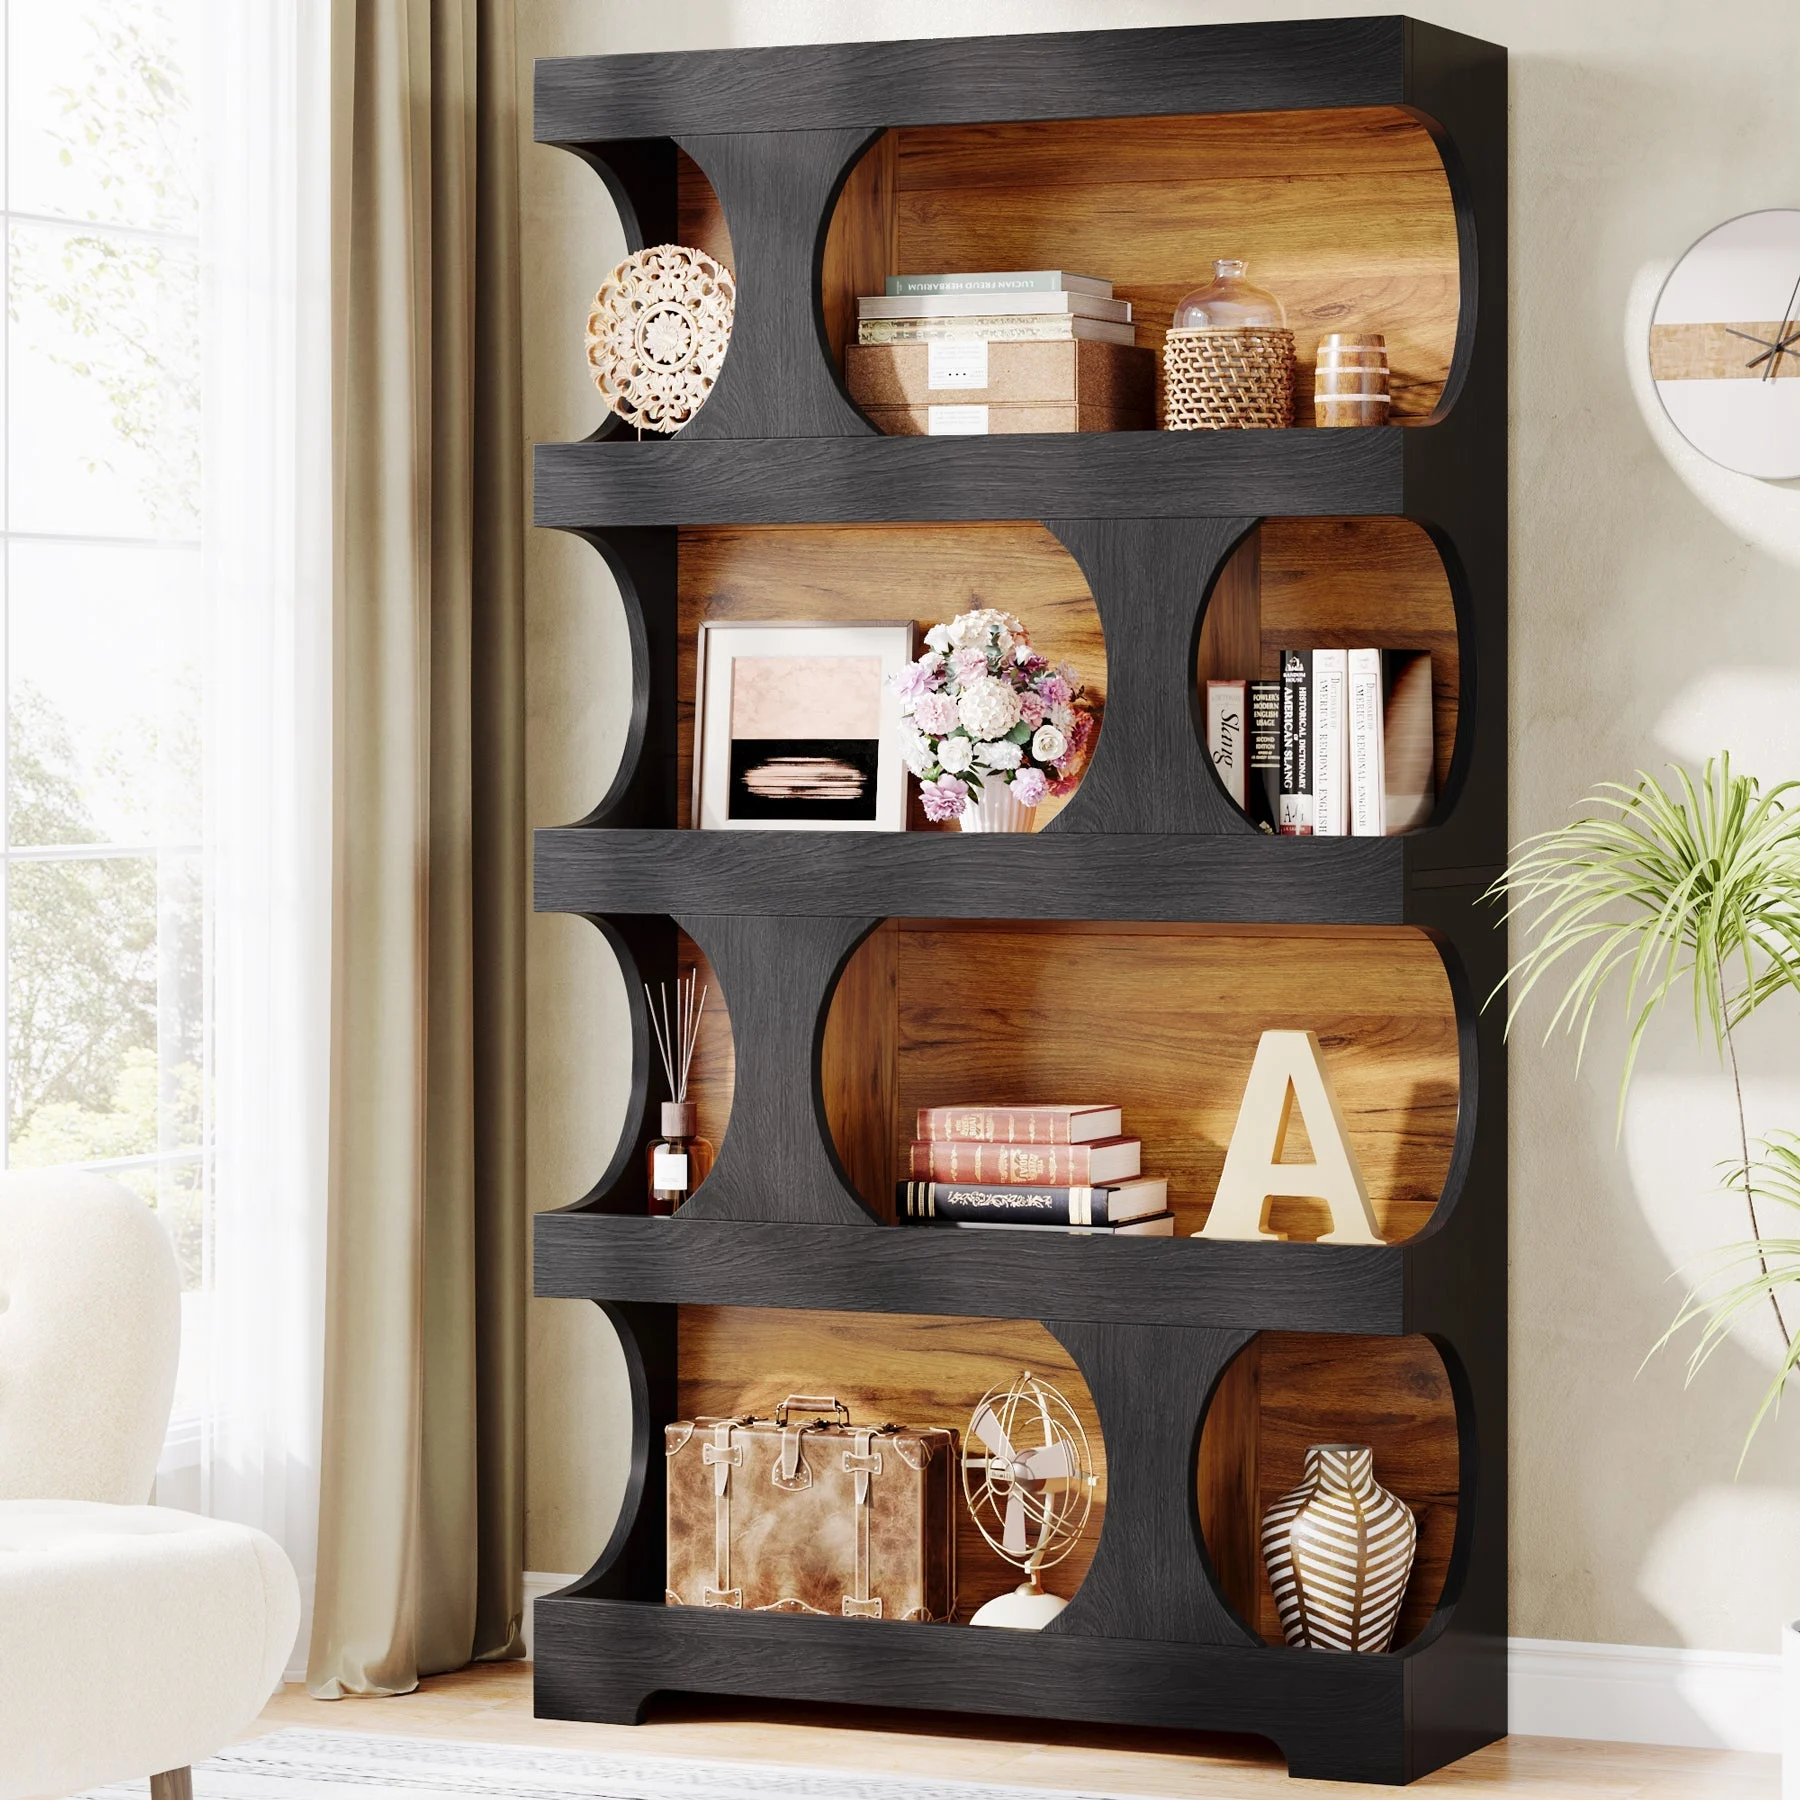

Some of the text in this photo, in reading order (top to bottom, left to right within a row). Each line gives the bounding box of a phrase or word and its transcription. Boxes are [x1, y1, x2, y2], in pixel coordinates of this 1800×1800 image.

[908, 282, 963, 291] HERBARIUM
[965, 281, 996, 290] FREUD
[998, 280, 1034, 289] LUCIAN
[1253, 693, 1280, 702] FOWLER'S
[1253, 702, 1279, 710] MODERN
[1253, 710, 1279, 718] ENGLISH
[1355, 683, 1365, 731] AMERICAN
[1213, 709, 1240, 768] Slang
[1284, 686, 1293, 789] AMERICAN SLANG
[1298, 686, 1307, 789] HISTORICAL DICTIONARY
[1318, 679, 1328, 833] AMERICAN REGIONAL ENGLISH
[1357, 735, 1366, 782] REGIONAL
[1190, 1029, 1386, 1244] A
